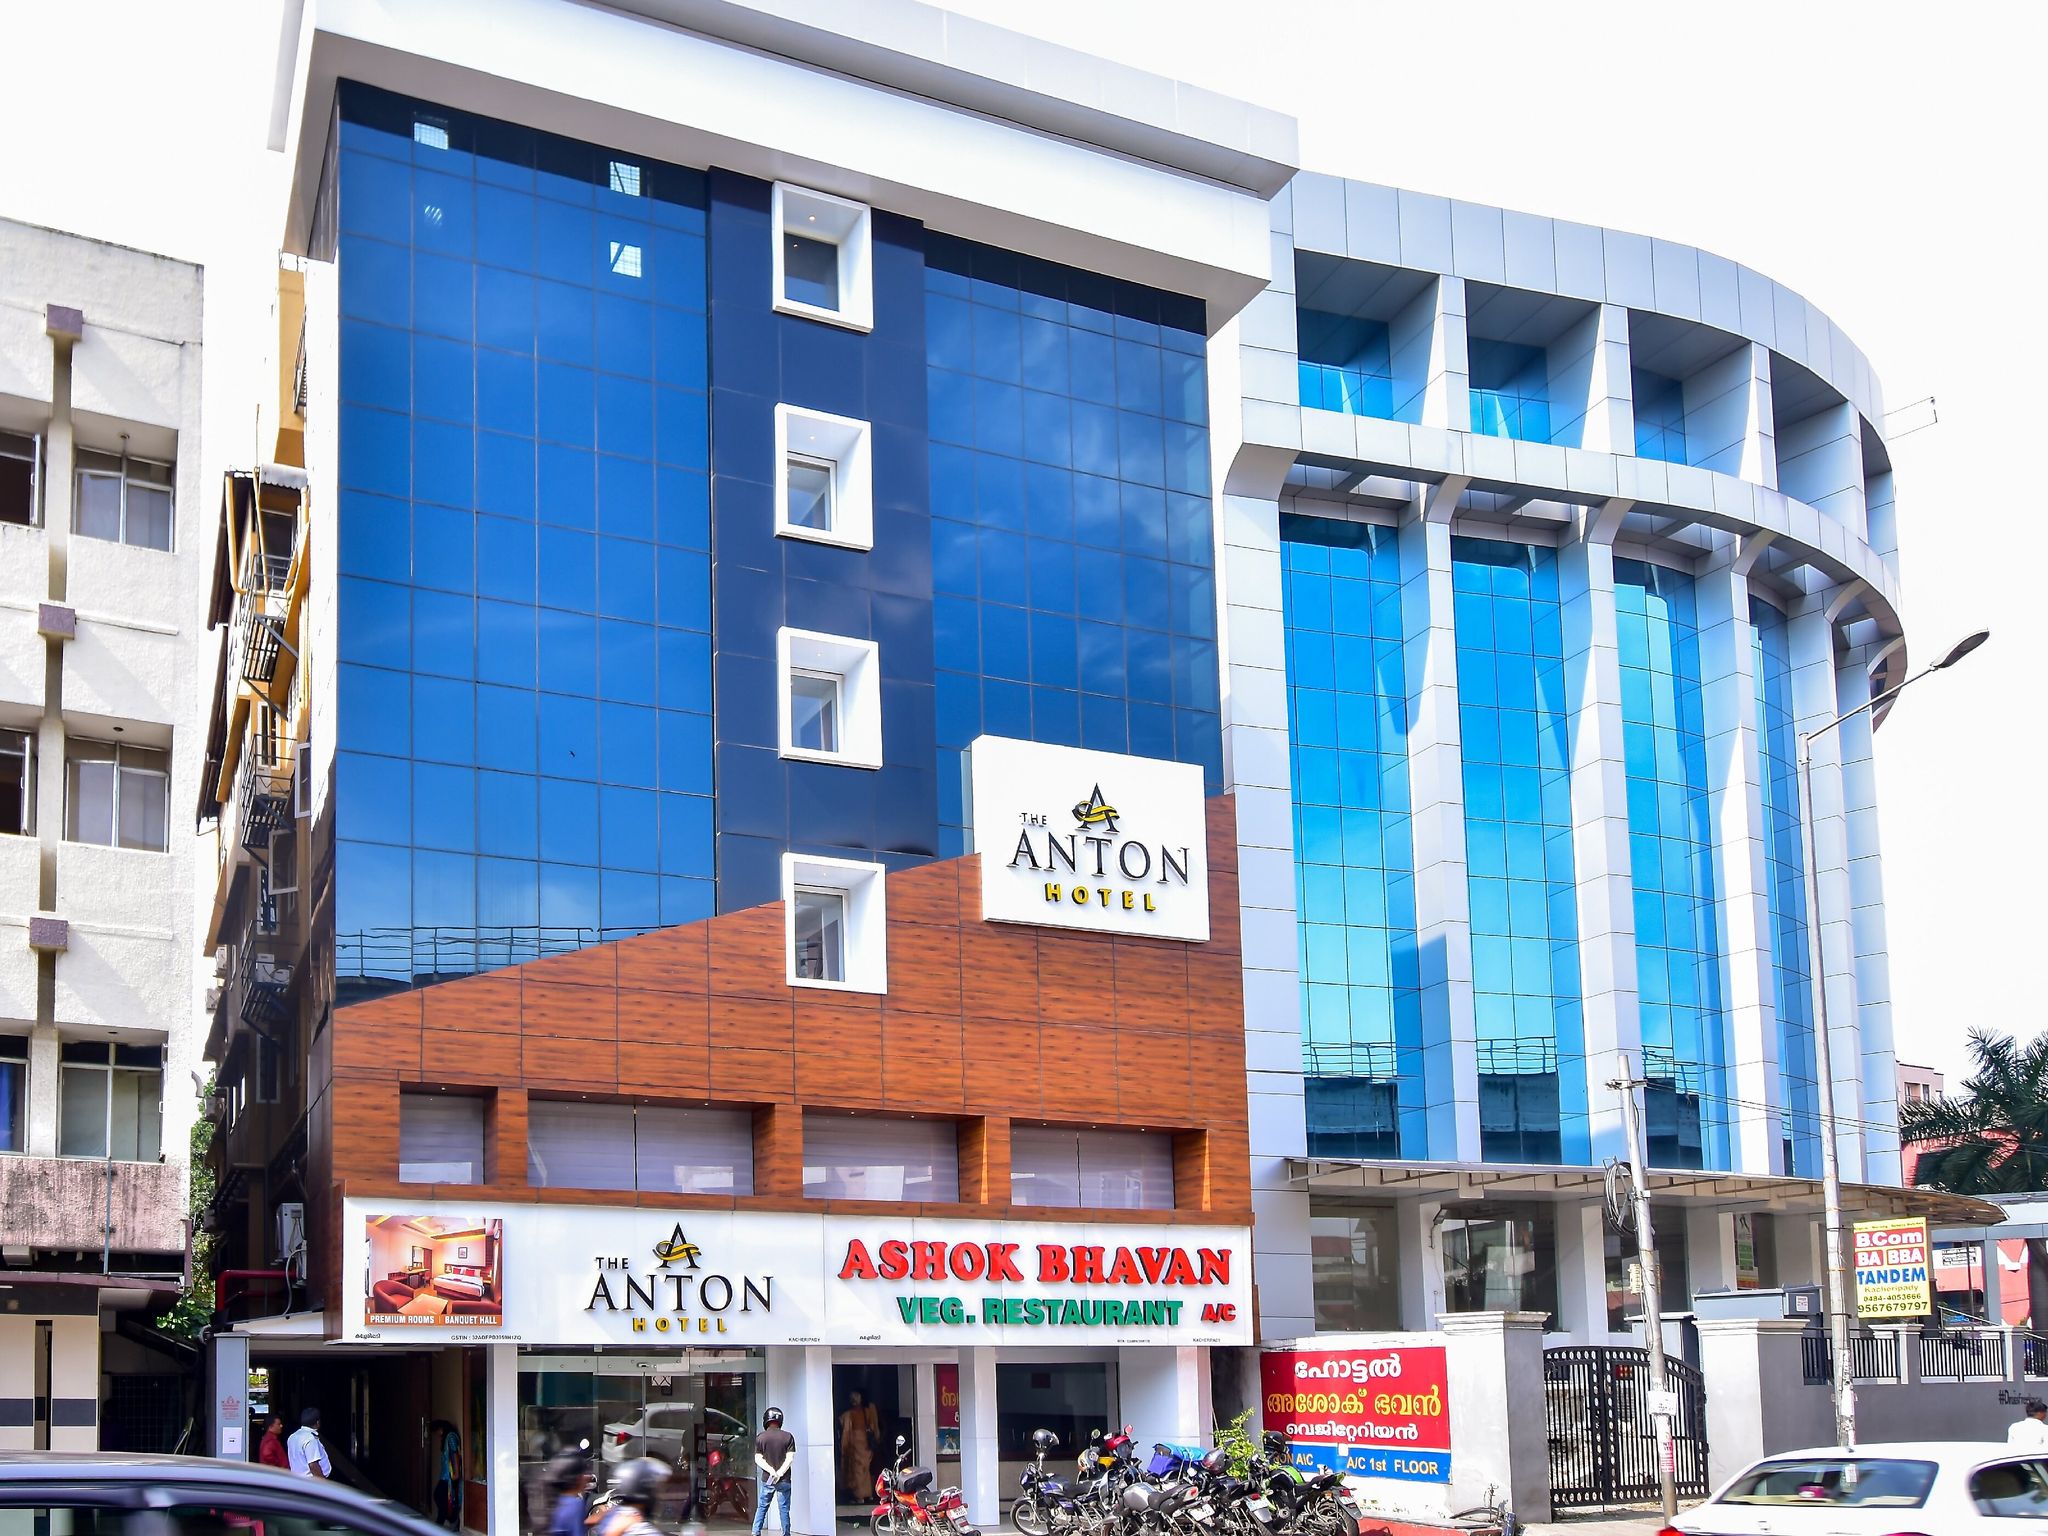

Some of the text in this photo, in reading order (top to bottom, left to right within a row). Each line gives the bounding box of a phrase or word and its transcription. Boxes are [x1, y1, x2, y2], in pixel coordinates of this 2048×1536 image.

[1020, 812, 1048, 826] THE
[1007, 828, 1190, 885] ANTON
[1045, 882, 1157, 911] HOTEL
[1856, 1231, 1923, 1248] B.Com
[595, 1256, 629, 1270] THE
[838, 1238, 1232, 1285] ASHOK BHAVAN
[1857, 1251, 1882, 1266] BA
[1888, 1248, 1923, 1264] BBA
[1857, 1267, 1926, 1285] TANDEM
[584, 1273, 774, 1313] ANTON
[1865, 1284, 1919, 1293] Kacheripady
[897, 1296, 1183, 1326] VEG. RESTAURANT
[1201, 1303, 1236, 1323] A/C
[1858, 1302, 1928, 1313] 9567679797
[370, 1314, 435, 1325] PREMIUM ROOMS
[444, 1315, 497, 1325] BANQUET HALL
[632, 1317, 727, 1332] HOTEL
[1294, 1353, 1402, 1384] ഹോട്ടൽ
[1267, 1384, 1442, 1417] അശോക് ഭവൻ
[1286, 1420, 1419, 1443] വെജിറ്റേറിയൻ
[1346, 1456, 1439, 1475] A/C 1st FLOOR
